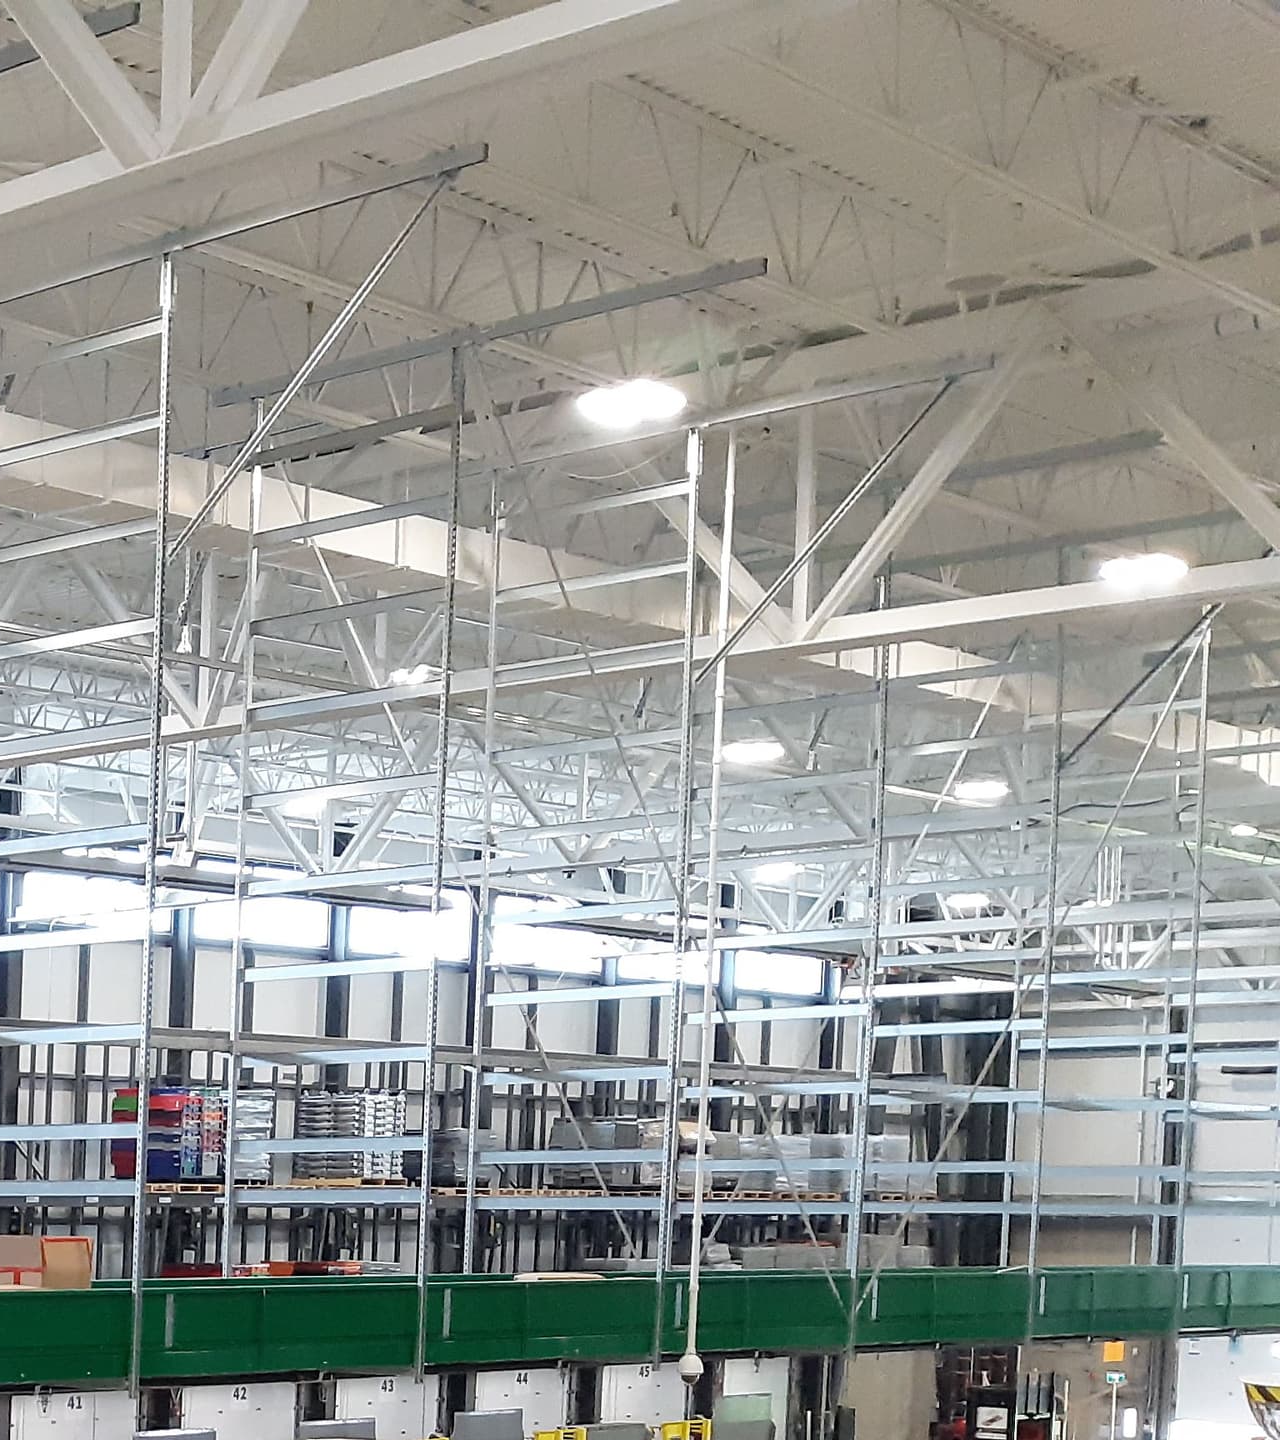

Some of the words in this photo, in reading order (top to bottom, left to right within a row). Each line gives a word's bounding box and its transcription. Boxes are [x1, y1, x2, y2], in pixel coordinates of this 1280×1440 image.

[516, 1371, 529, 1385] 44
[638, 1365, 651, 1378] 45
[381, 1378, 395, 1393] 43
[232, 1386, 248, 1401] 42
[66, 1395, 83, 1410] 41
